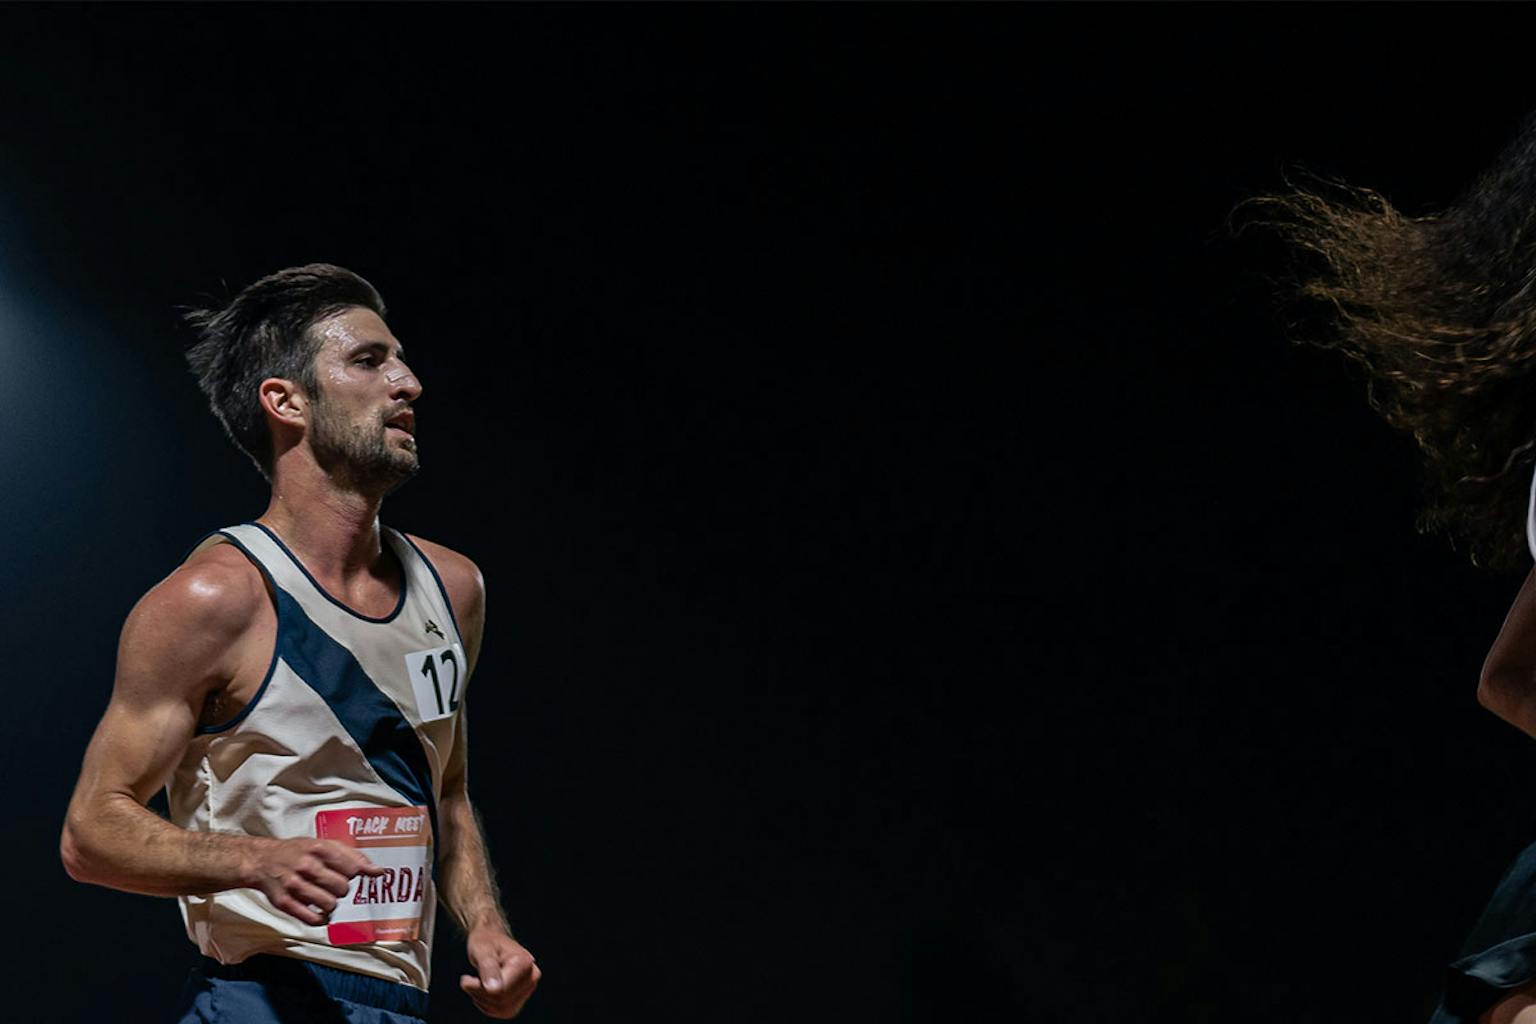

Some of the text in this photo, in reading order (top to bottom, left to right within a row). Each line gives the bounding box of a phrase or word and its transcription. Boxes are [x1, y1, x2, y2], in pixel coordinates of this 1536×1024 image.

[421, 649, 459, 715] 12
[346, 815, 390, 835] TRACK
[394, 814, 426, 833] MEET
